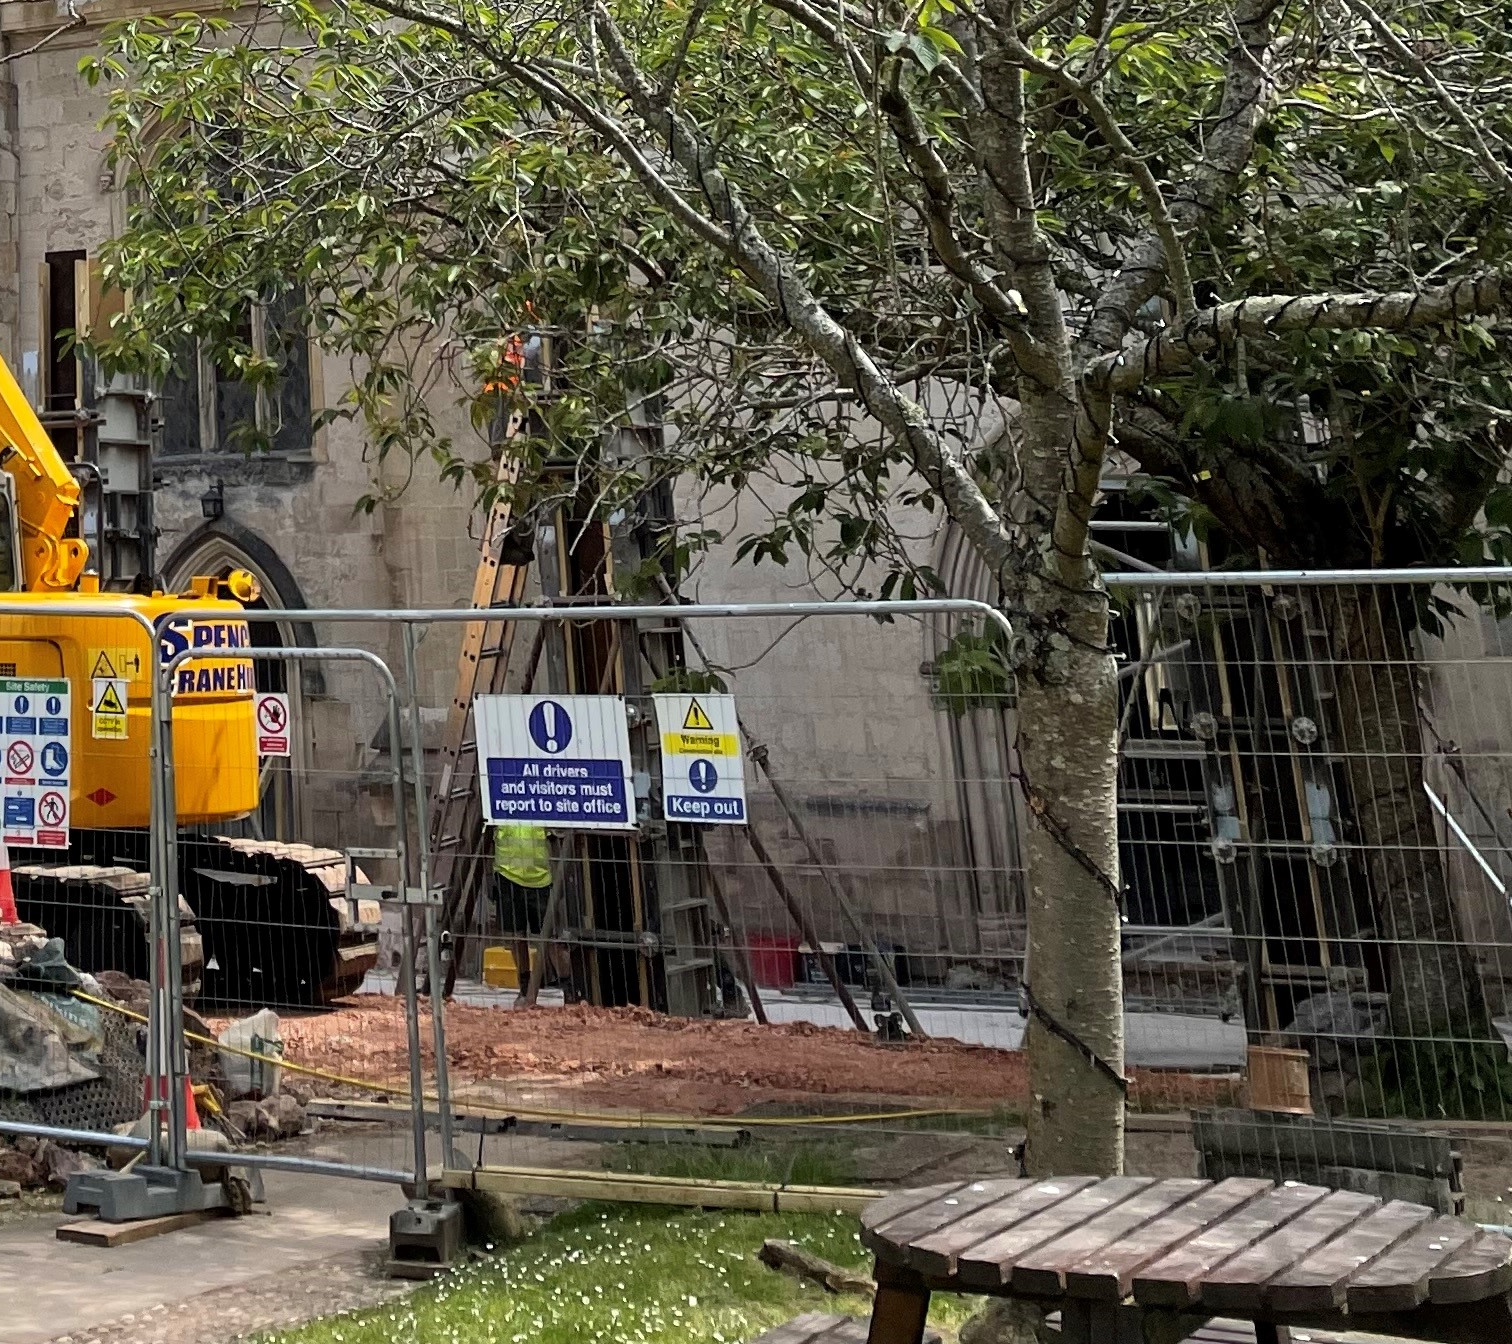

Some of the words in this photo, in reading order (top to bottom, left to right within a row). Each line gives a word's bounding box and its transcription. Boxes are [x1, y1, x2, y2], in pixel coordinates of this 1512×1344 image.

[6, 682, 22, 691] Site
[24, 682, 50, 692] Safety
[681, 735, 720, 747] Warning
[522, 764, 539, 777] All
[543, 765, 588, 777] drivers
[501, 780, 526, 795] and
[529, 781, 577, 796] visitors
[580, 782, 612, 797] must
[495, 798, 535, 815] report
[539, 799, 552, 812] to
[555, 800, 581, 813] site
[584, 801, 621, 814] office
[672, 798, 710, 816] Keep
[714, 800, 739, 816] out
